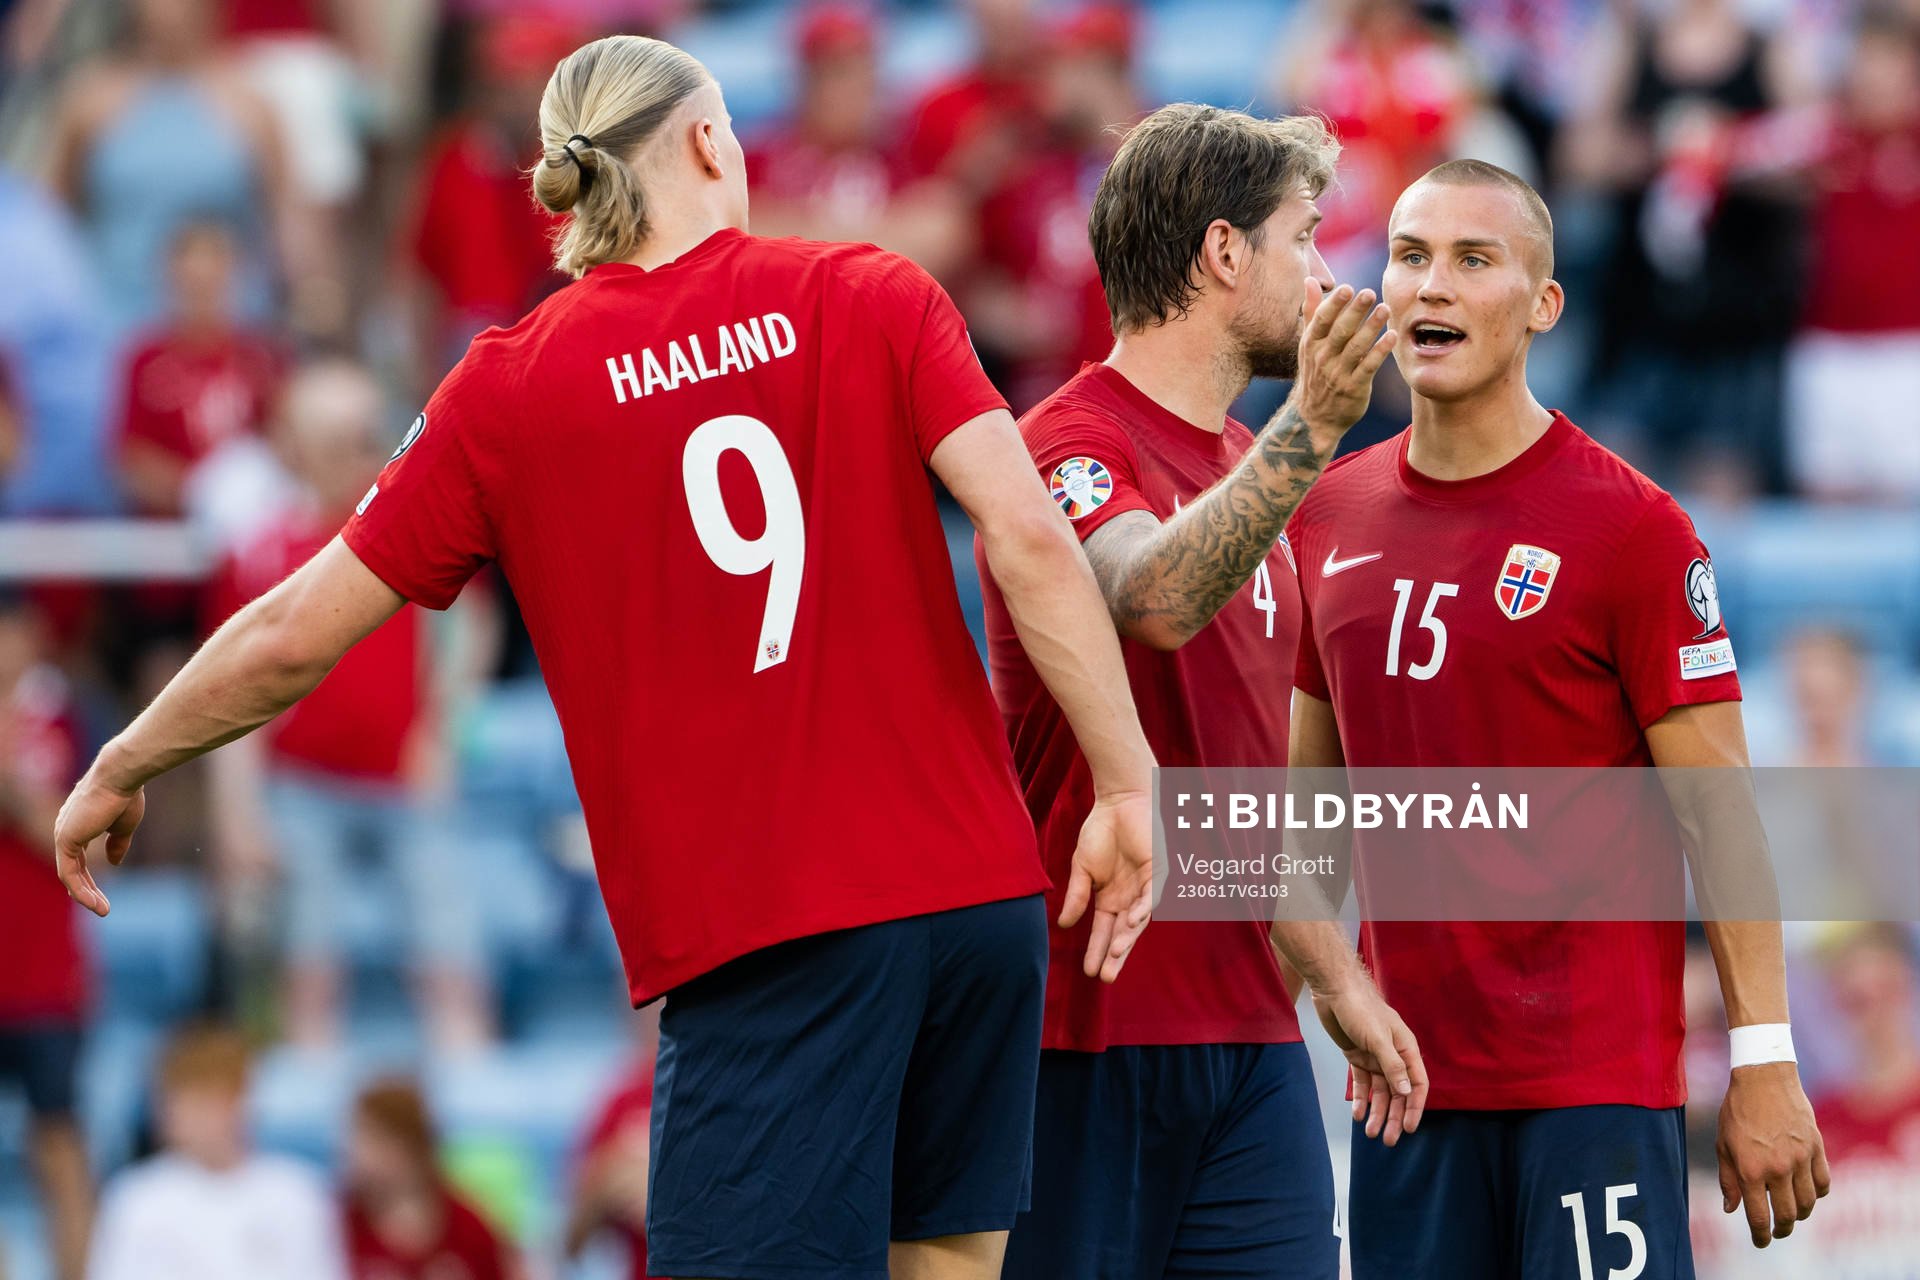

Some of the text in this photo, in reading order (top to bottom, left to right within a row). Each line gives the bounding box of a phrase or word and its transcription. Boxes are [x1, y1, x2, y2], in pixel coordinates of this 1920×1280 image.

[605, 312, 797, 404] HAALAND
[682, 414, 806, 674] 9
[1252, 558, 1277, 639] 4
[1385, 578, 1460, 681] 15
[1681, 647, 1701, 656] UEFA
[1560, 1182, 1648, 1280] 15
